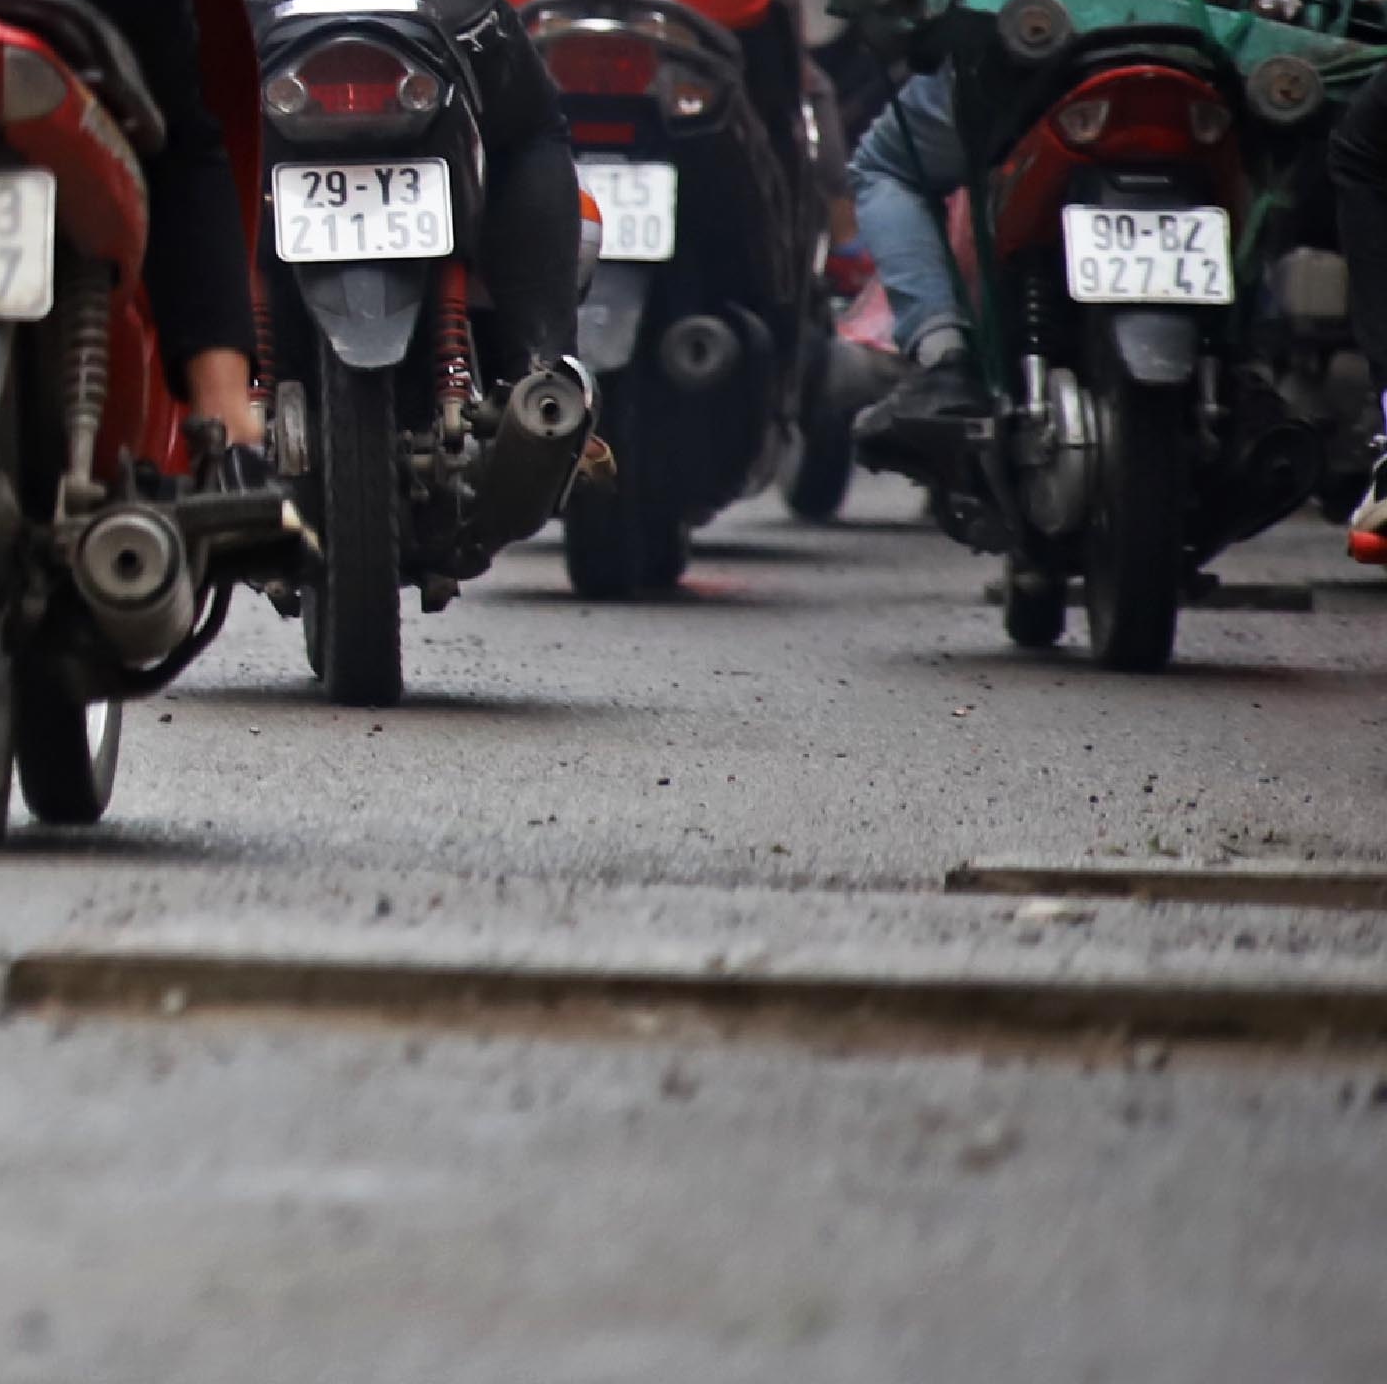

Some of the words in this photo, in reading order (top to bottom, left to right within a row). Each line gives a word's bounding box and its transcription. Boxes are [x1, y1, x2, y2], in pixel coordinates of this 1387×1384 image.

[301, 168, 421, 208] 29-Y3
[290, 211, 439, 254] 211.59
[1079, 257, 1222, 296] 927.42
